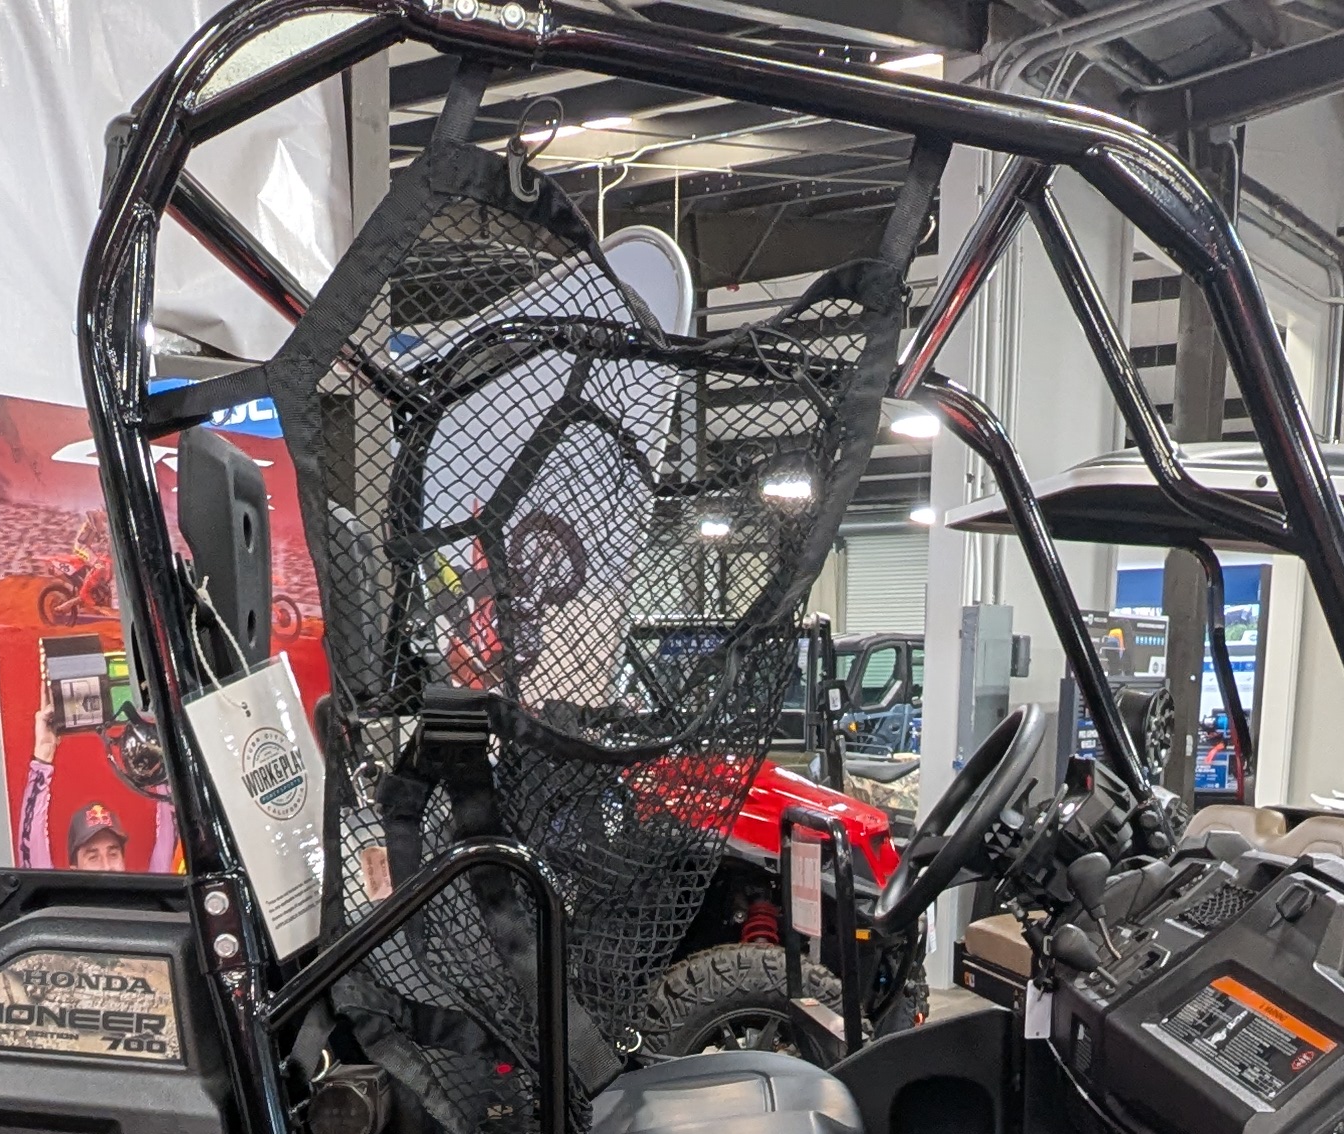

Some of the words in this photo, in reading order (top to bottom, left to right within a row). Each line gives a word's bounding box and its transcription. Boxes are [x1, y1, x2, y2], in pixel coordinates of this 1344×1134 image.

[22, 969, 155, 994] HONDA
[25, 1030, 79, 1040] EDITION
[101, 1036, 166, 1053] 700
